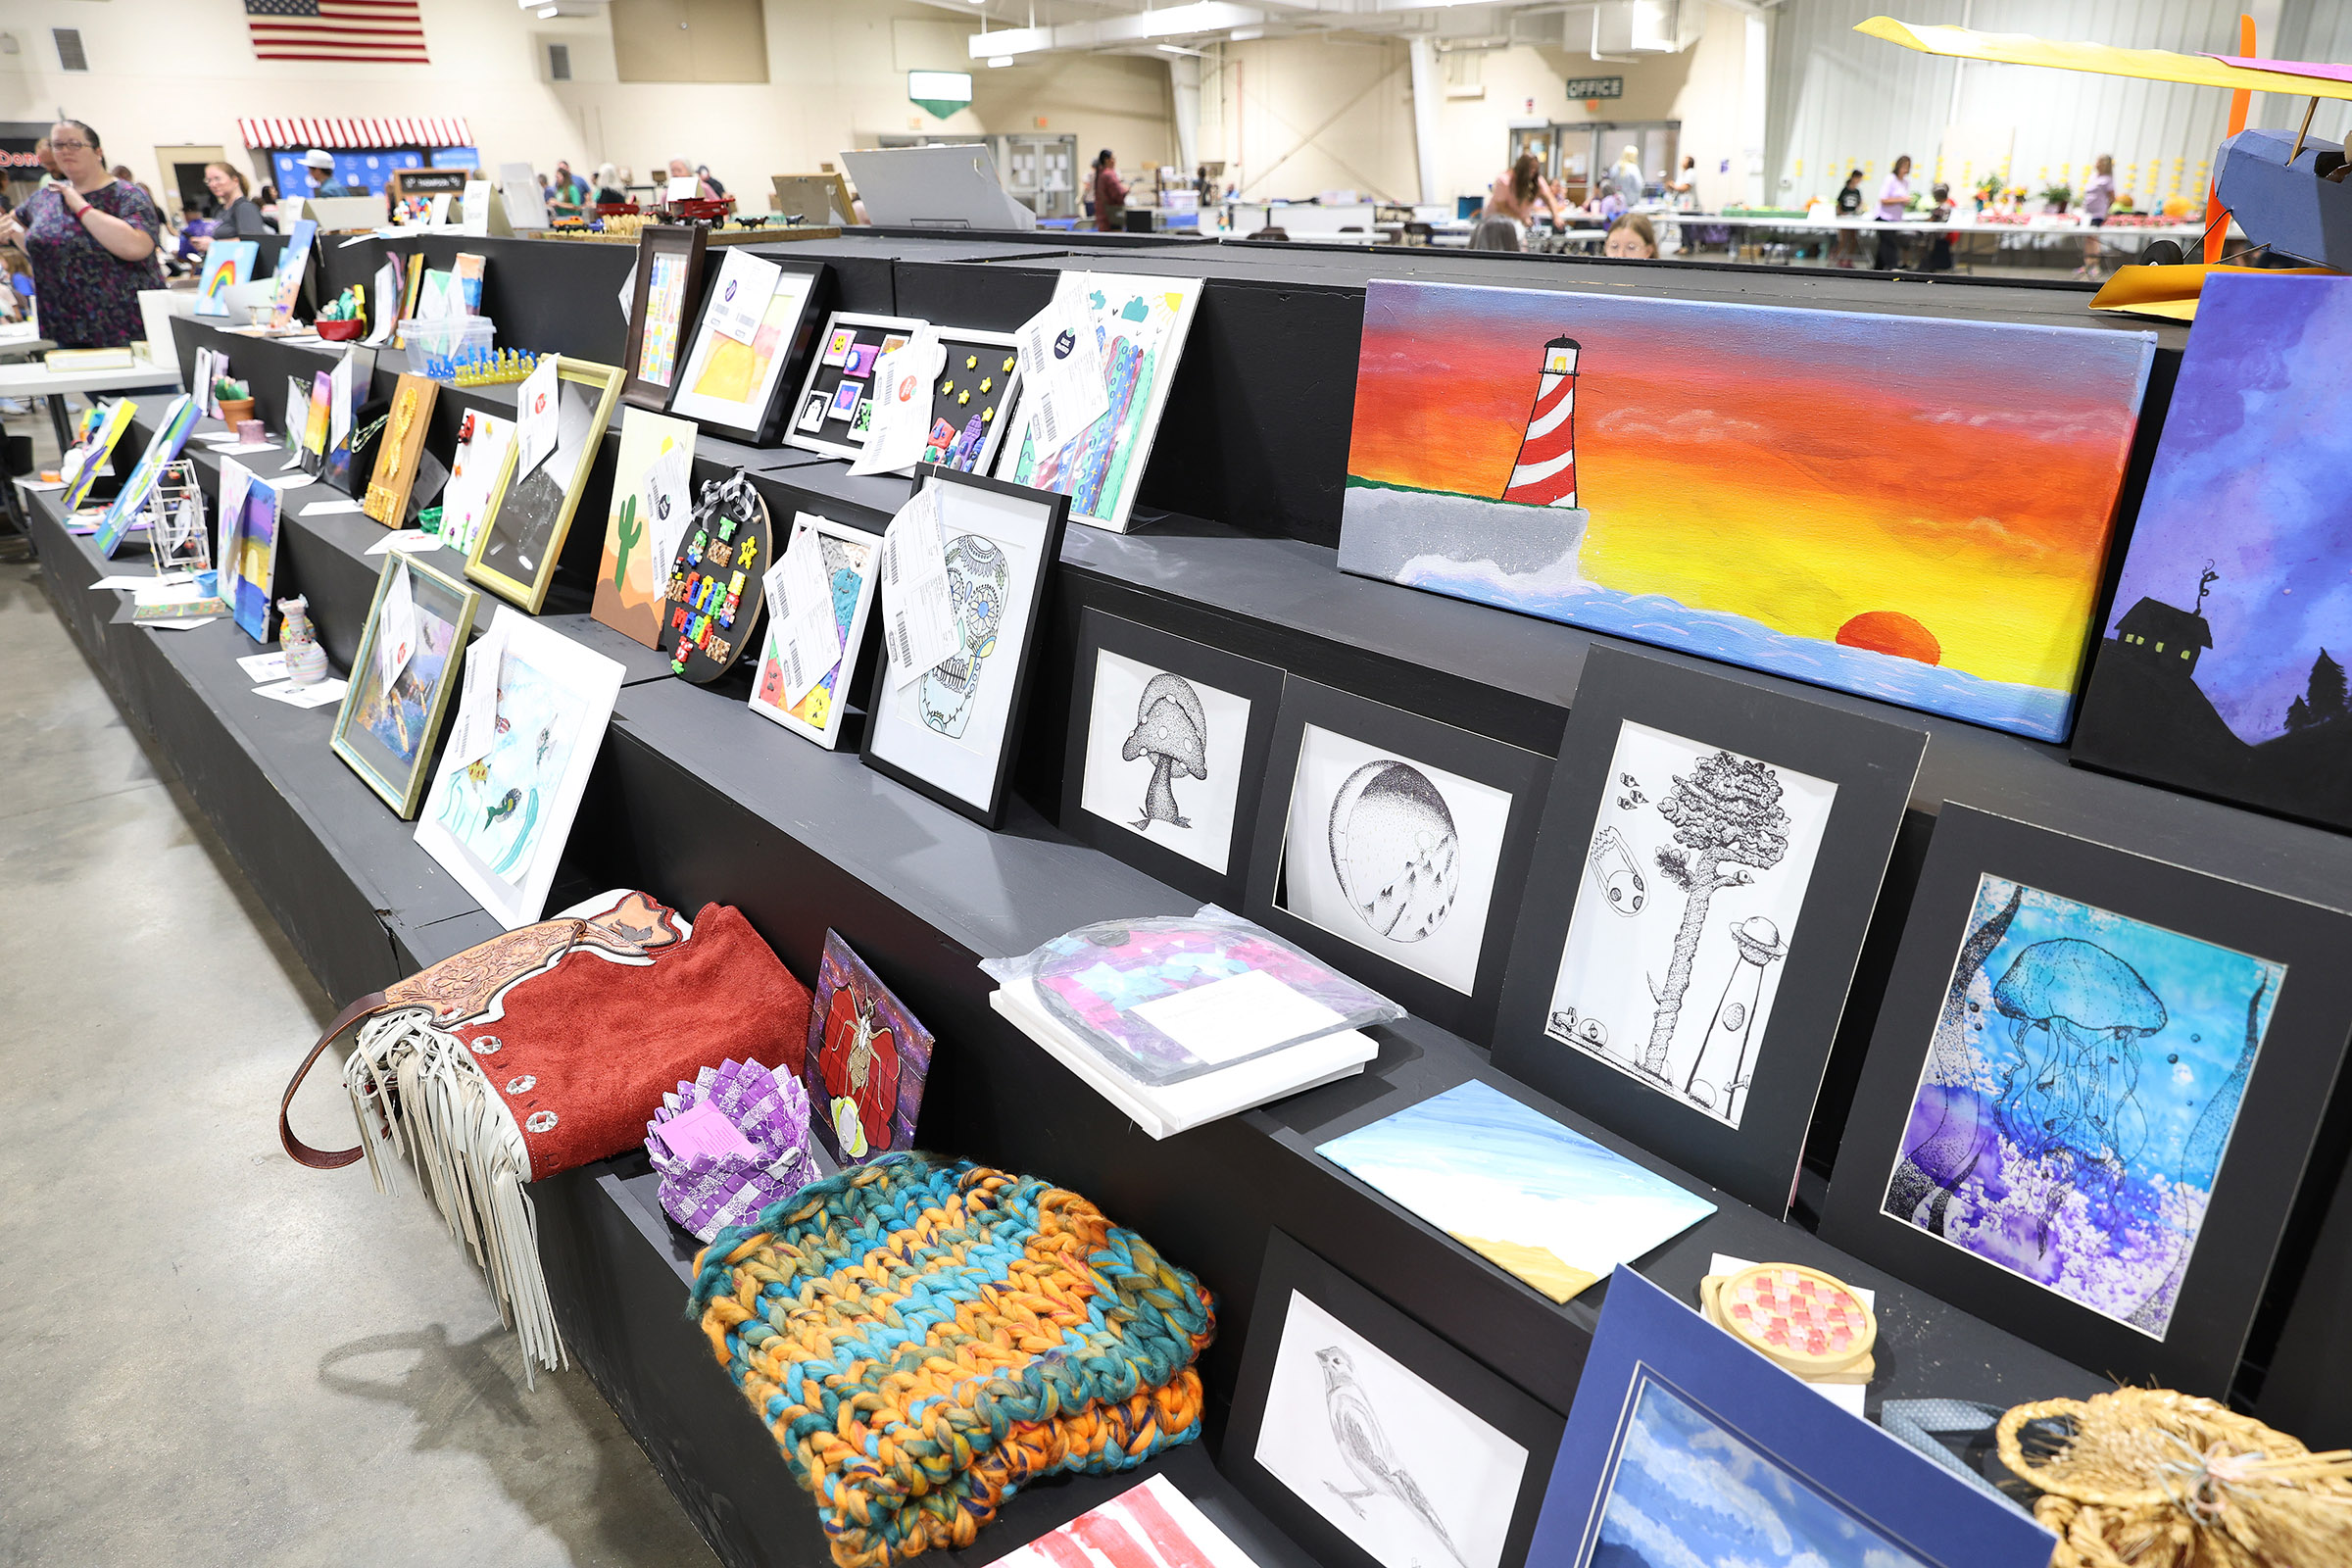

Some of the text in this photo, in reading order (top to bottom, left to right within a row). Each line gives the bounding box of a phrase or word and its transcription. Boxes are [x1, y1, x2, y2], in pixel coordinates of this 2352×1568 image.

[1569, 79, 1620, 96] OFFICE
[682, 570, 728, 620] SUPER
[670, 607, 714, 651] MARIO
